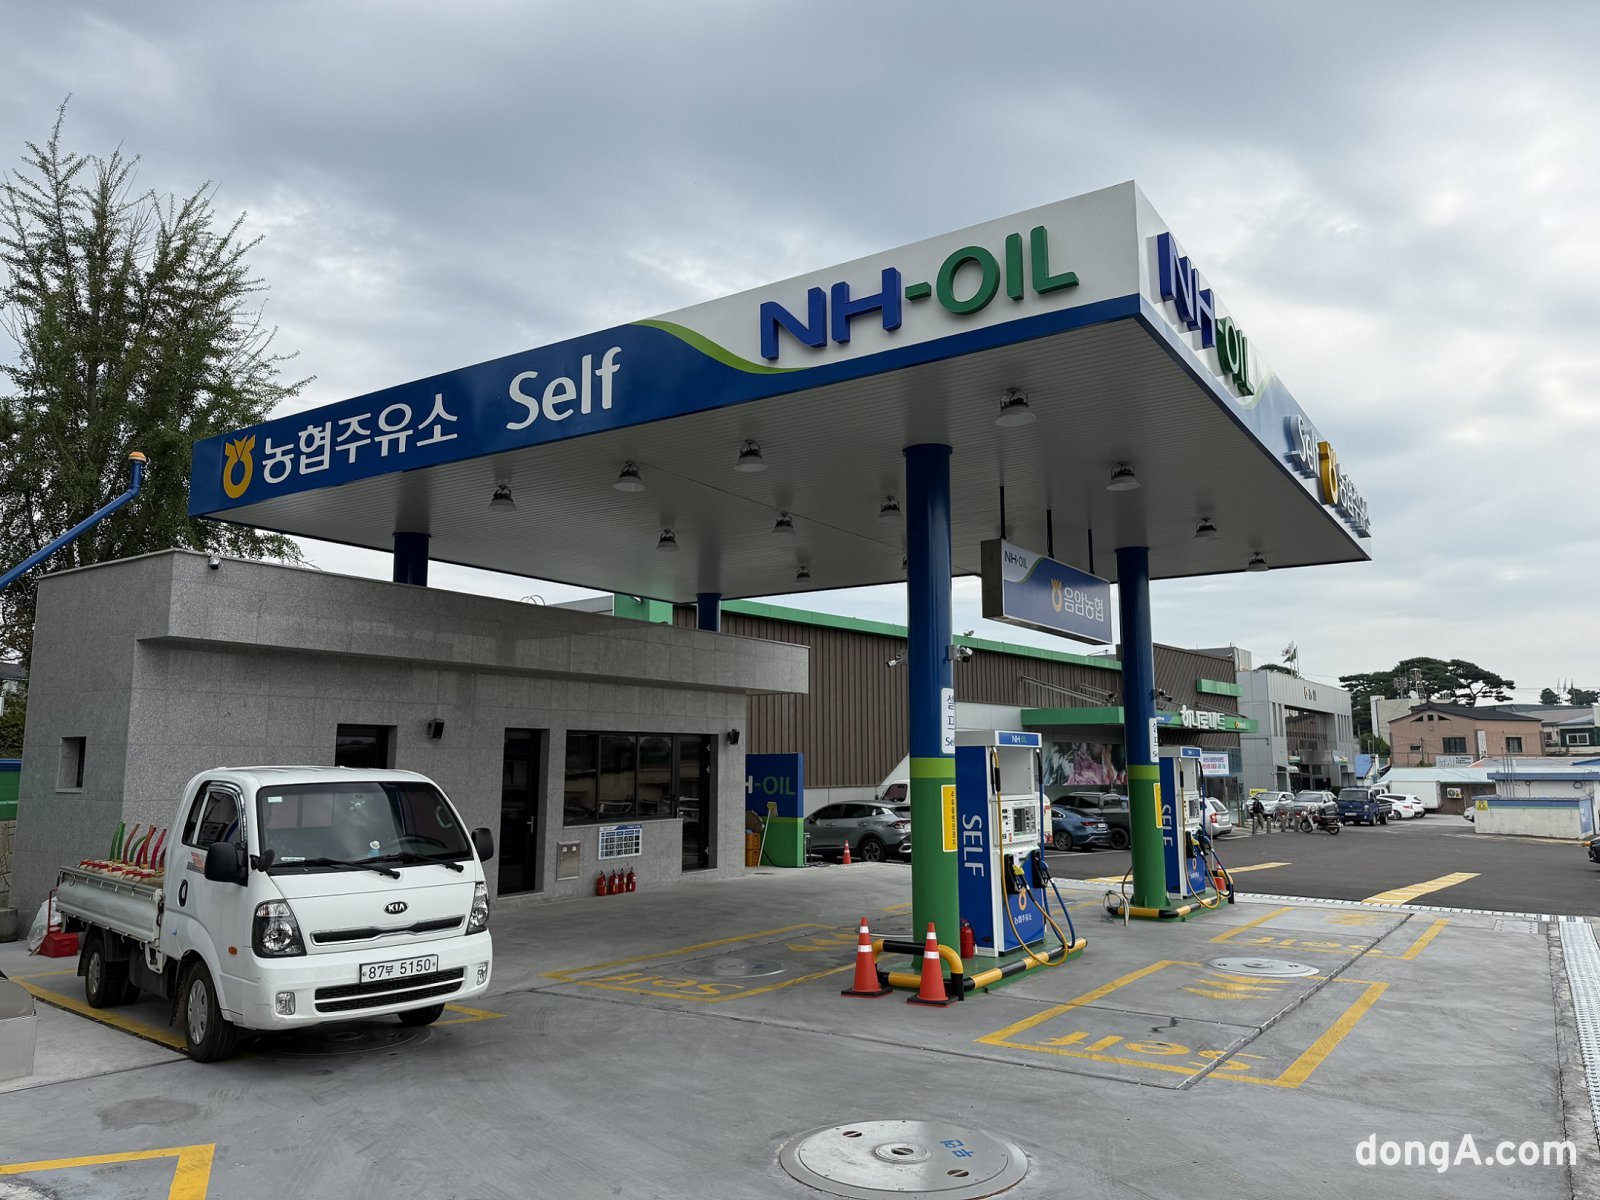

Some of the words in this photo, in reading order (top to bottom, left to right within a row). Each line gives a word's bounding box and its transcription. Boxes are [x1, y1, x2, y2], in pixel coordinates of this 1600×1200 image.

[760, 225, 1080, 361] NH-OIL
[505, 346, 622, 431] Self
[262, 393, 458, 484] 농협주유소
[1004, 550, 1028, 569] NH-OIL
[1064, 586, 1104, 622] 음암농협
[962, 814, 984, 877] SELF
[387, 902, 407, 913] KIA
[368, 964, 394, 979] 87부
[399, 958, 431, 975] 5150
